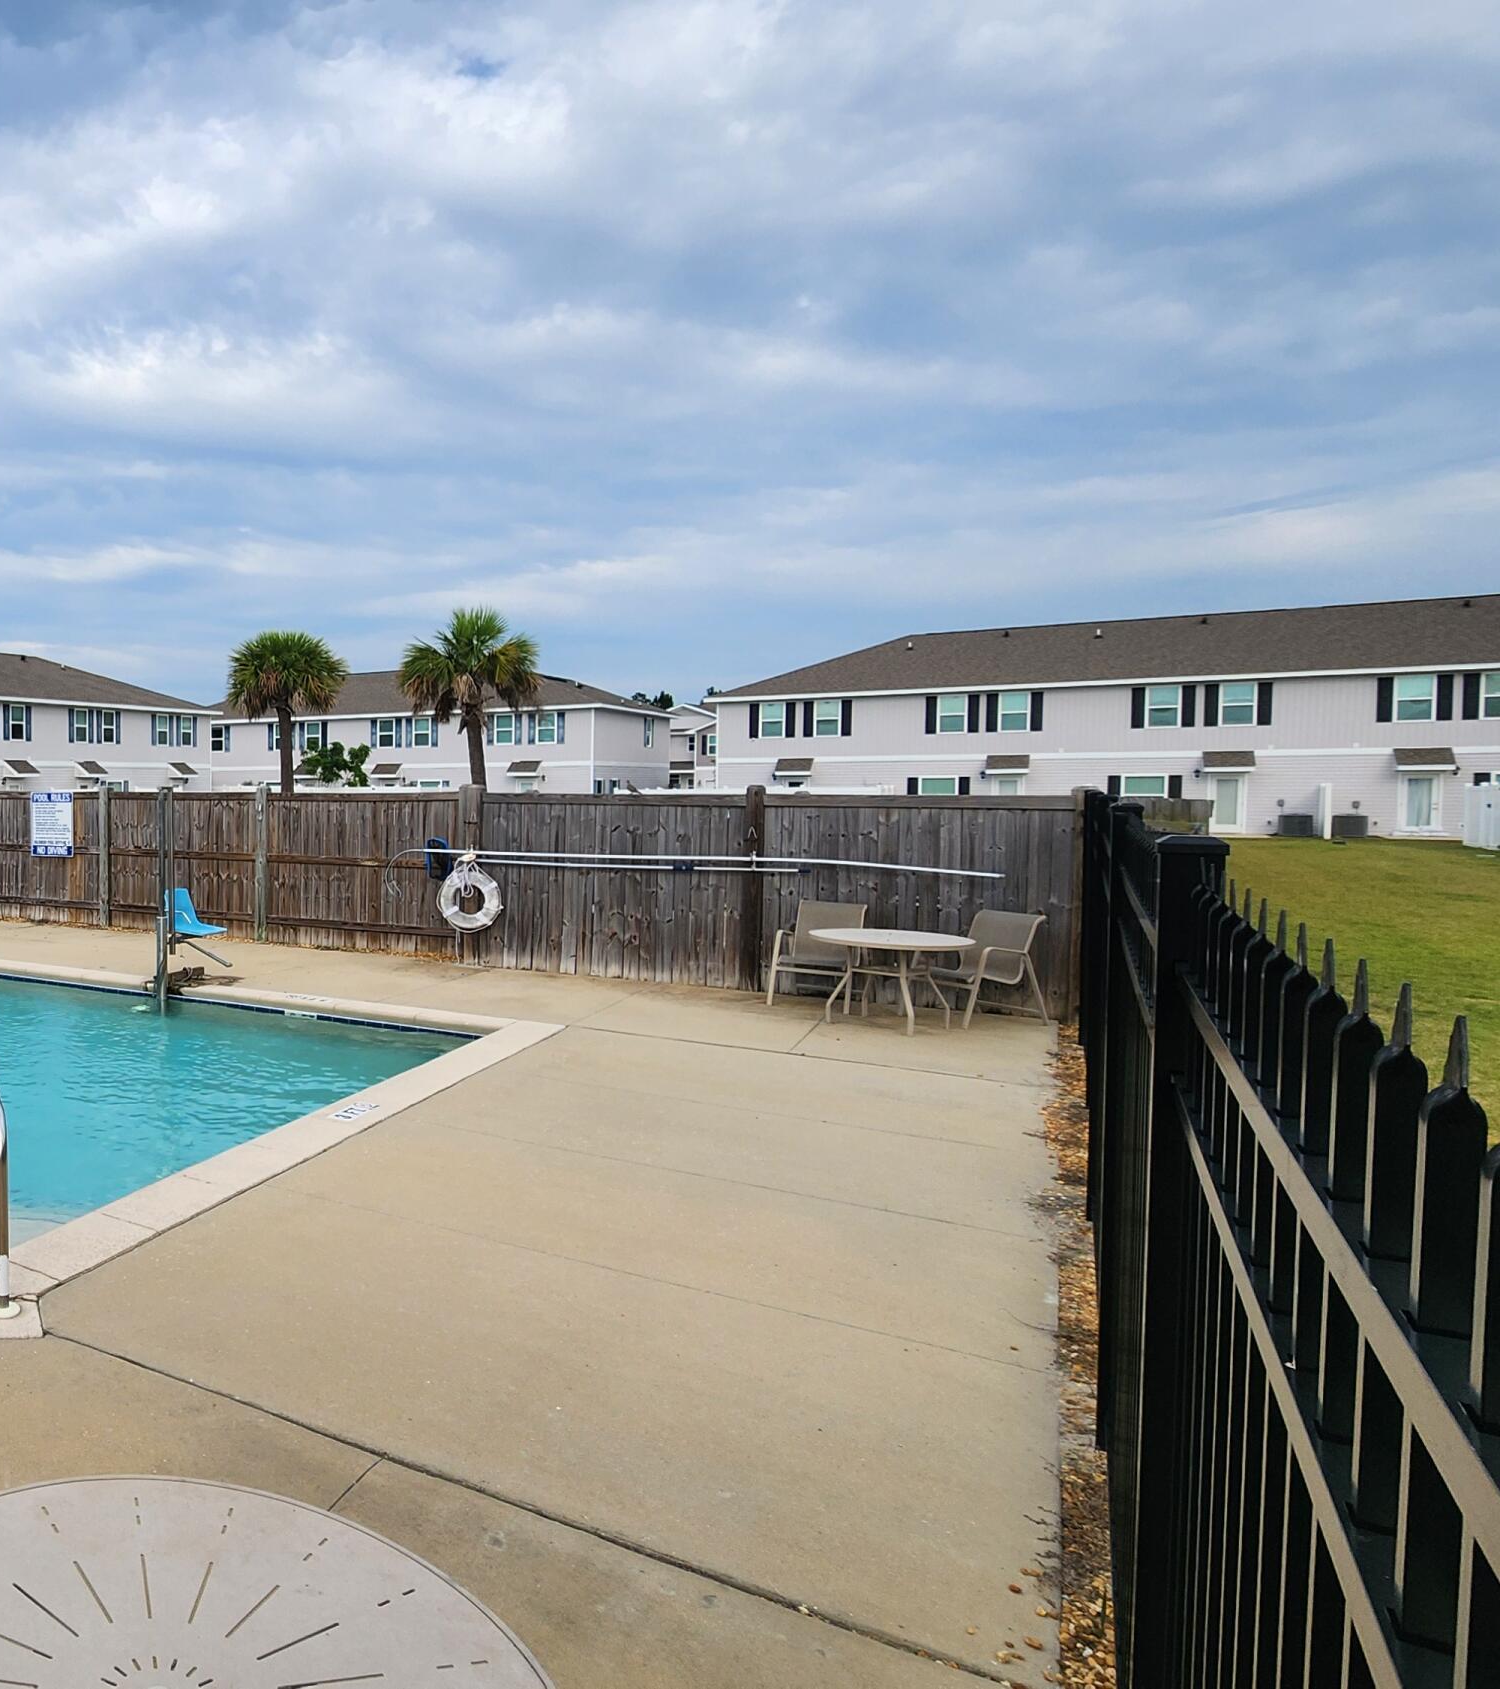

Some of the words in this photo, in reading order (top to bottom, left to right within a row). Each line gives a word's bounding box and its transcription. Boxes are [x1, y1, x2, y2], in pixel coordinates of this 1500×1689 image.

[33, 793, 49, 801] POOL
[51, 793, 71, 801] RULES
[36, 845, 46, 854] NO
[47, 845, 68, 855] DIVING
